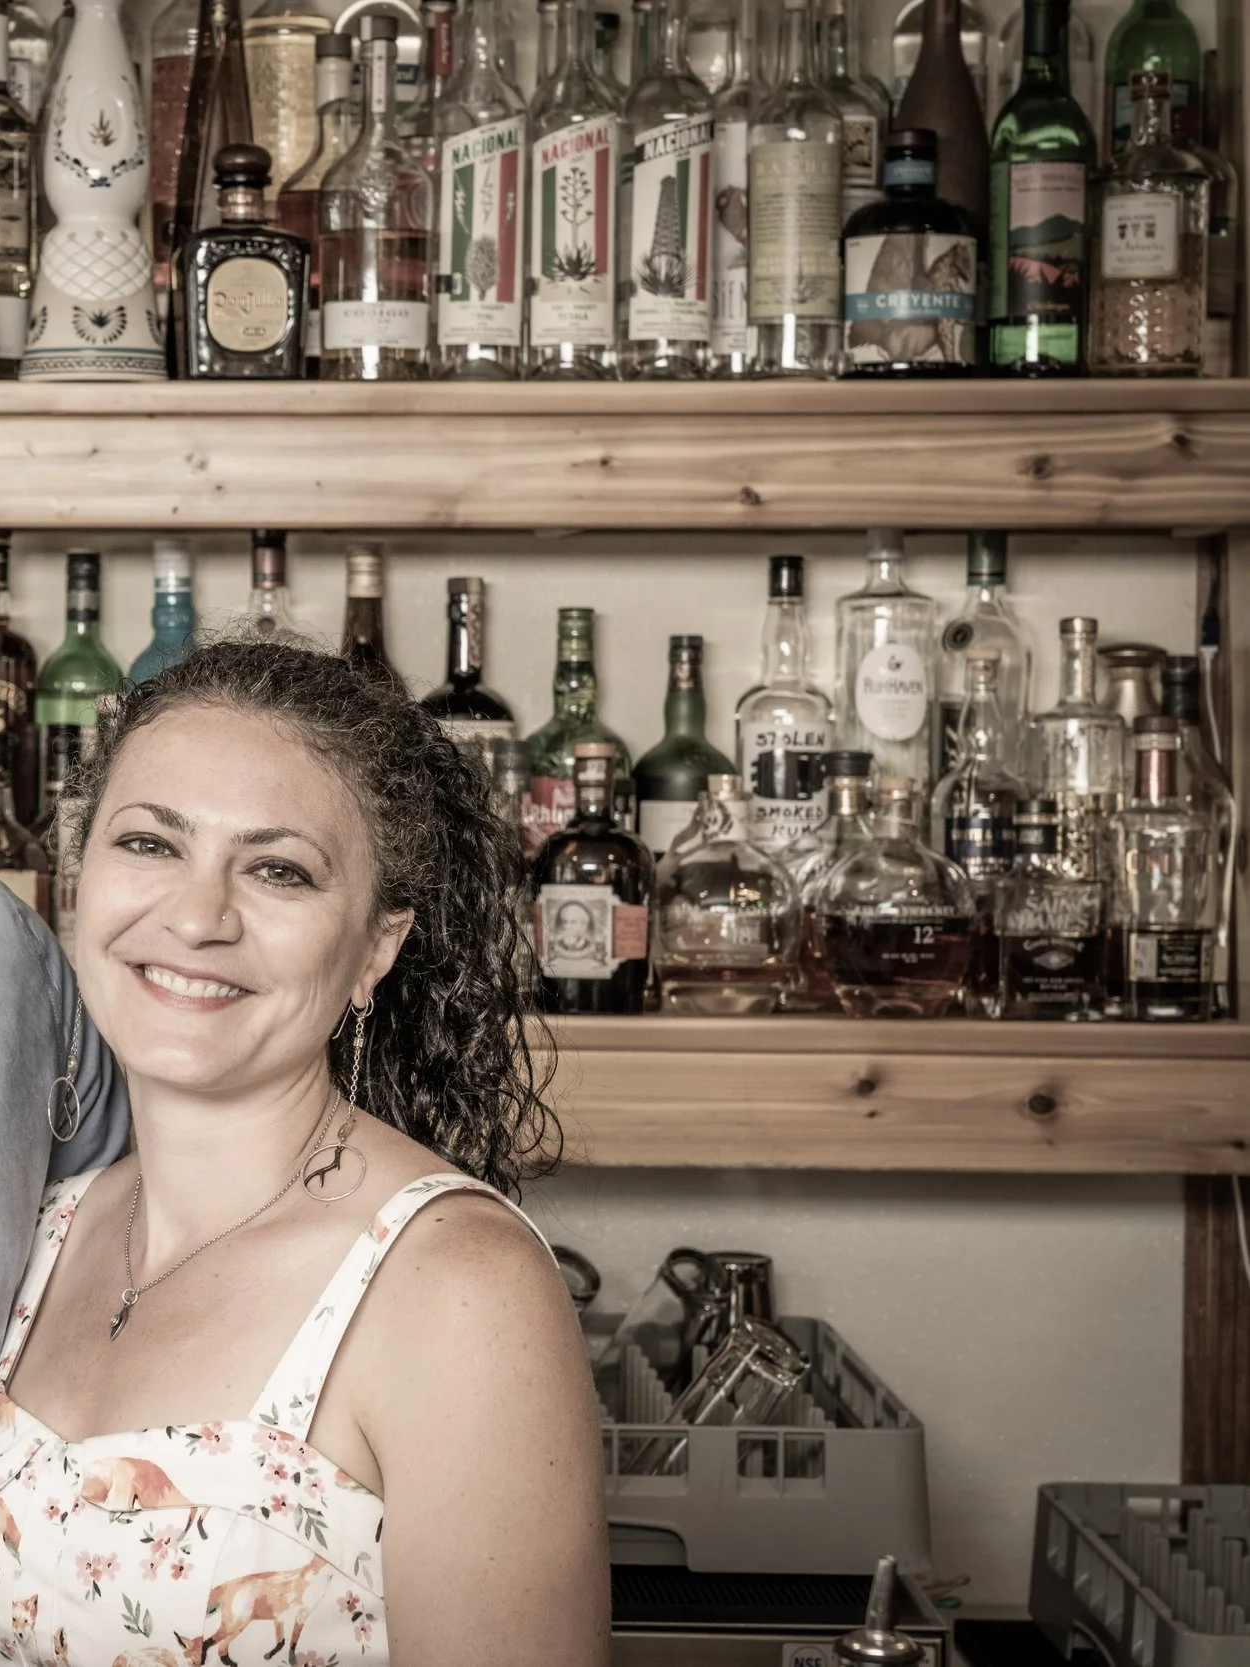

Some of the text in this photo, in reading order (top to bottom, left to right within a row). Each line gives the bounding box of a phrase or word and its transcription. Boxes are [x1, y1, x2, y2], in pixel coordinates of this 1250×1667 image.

[451, 127, 519, 165] NACIONAL
[541, 127, 610, 166] NACIONAL
[875, 293, 961, 309] CREYENTE
[755, 728, 826, 747] STOLEN
[755, 805, 825, 822] SMOKED
[913, 925, 935, 945] 12
